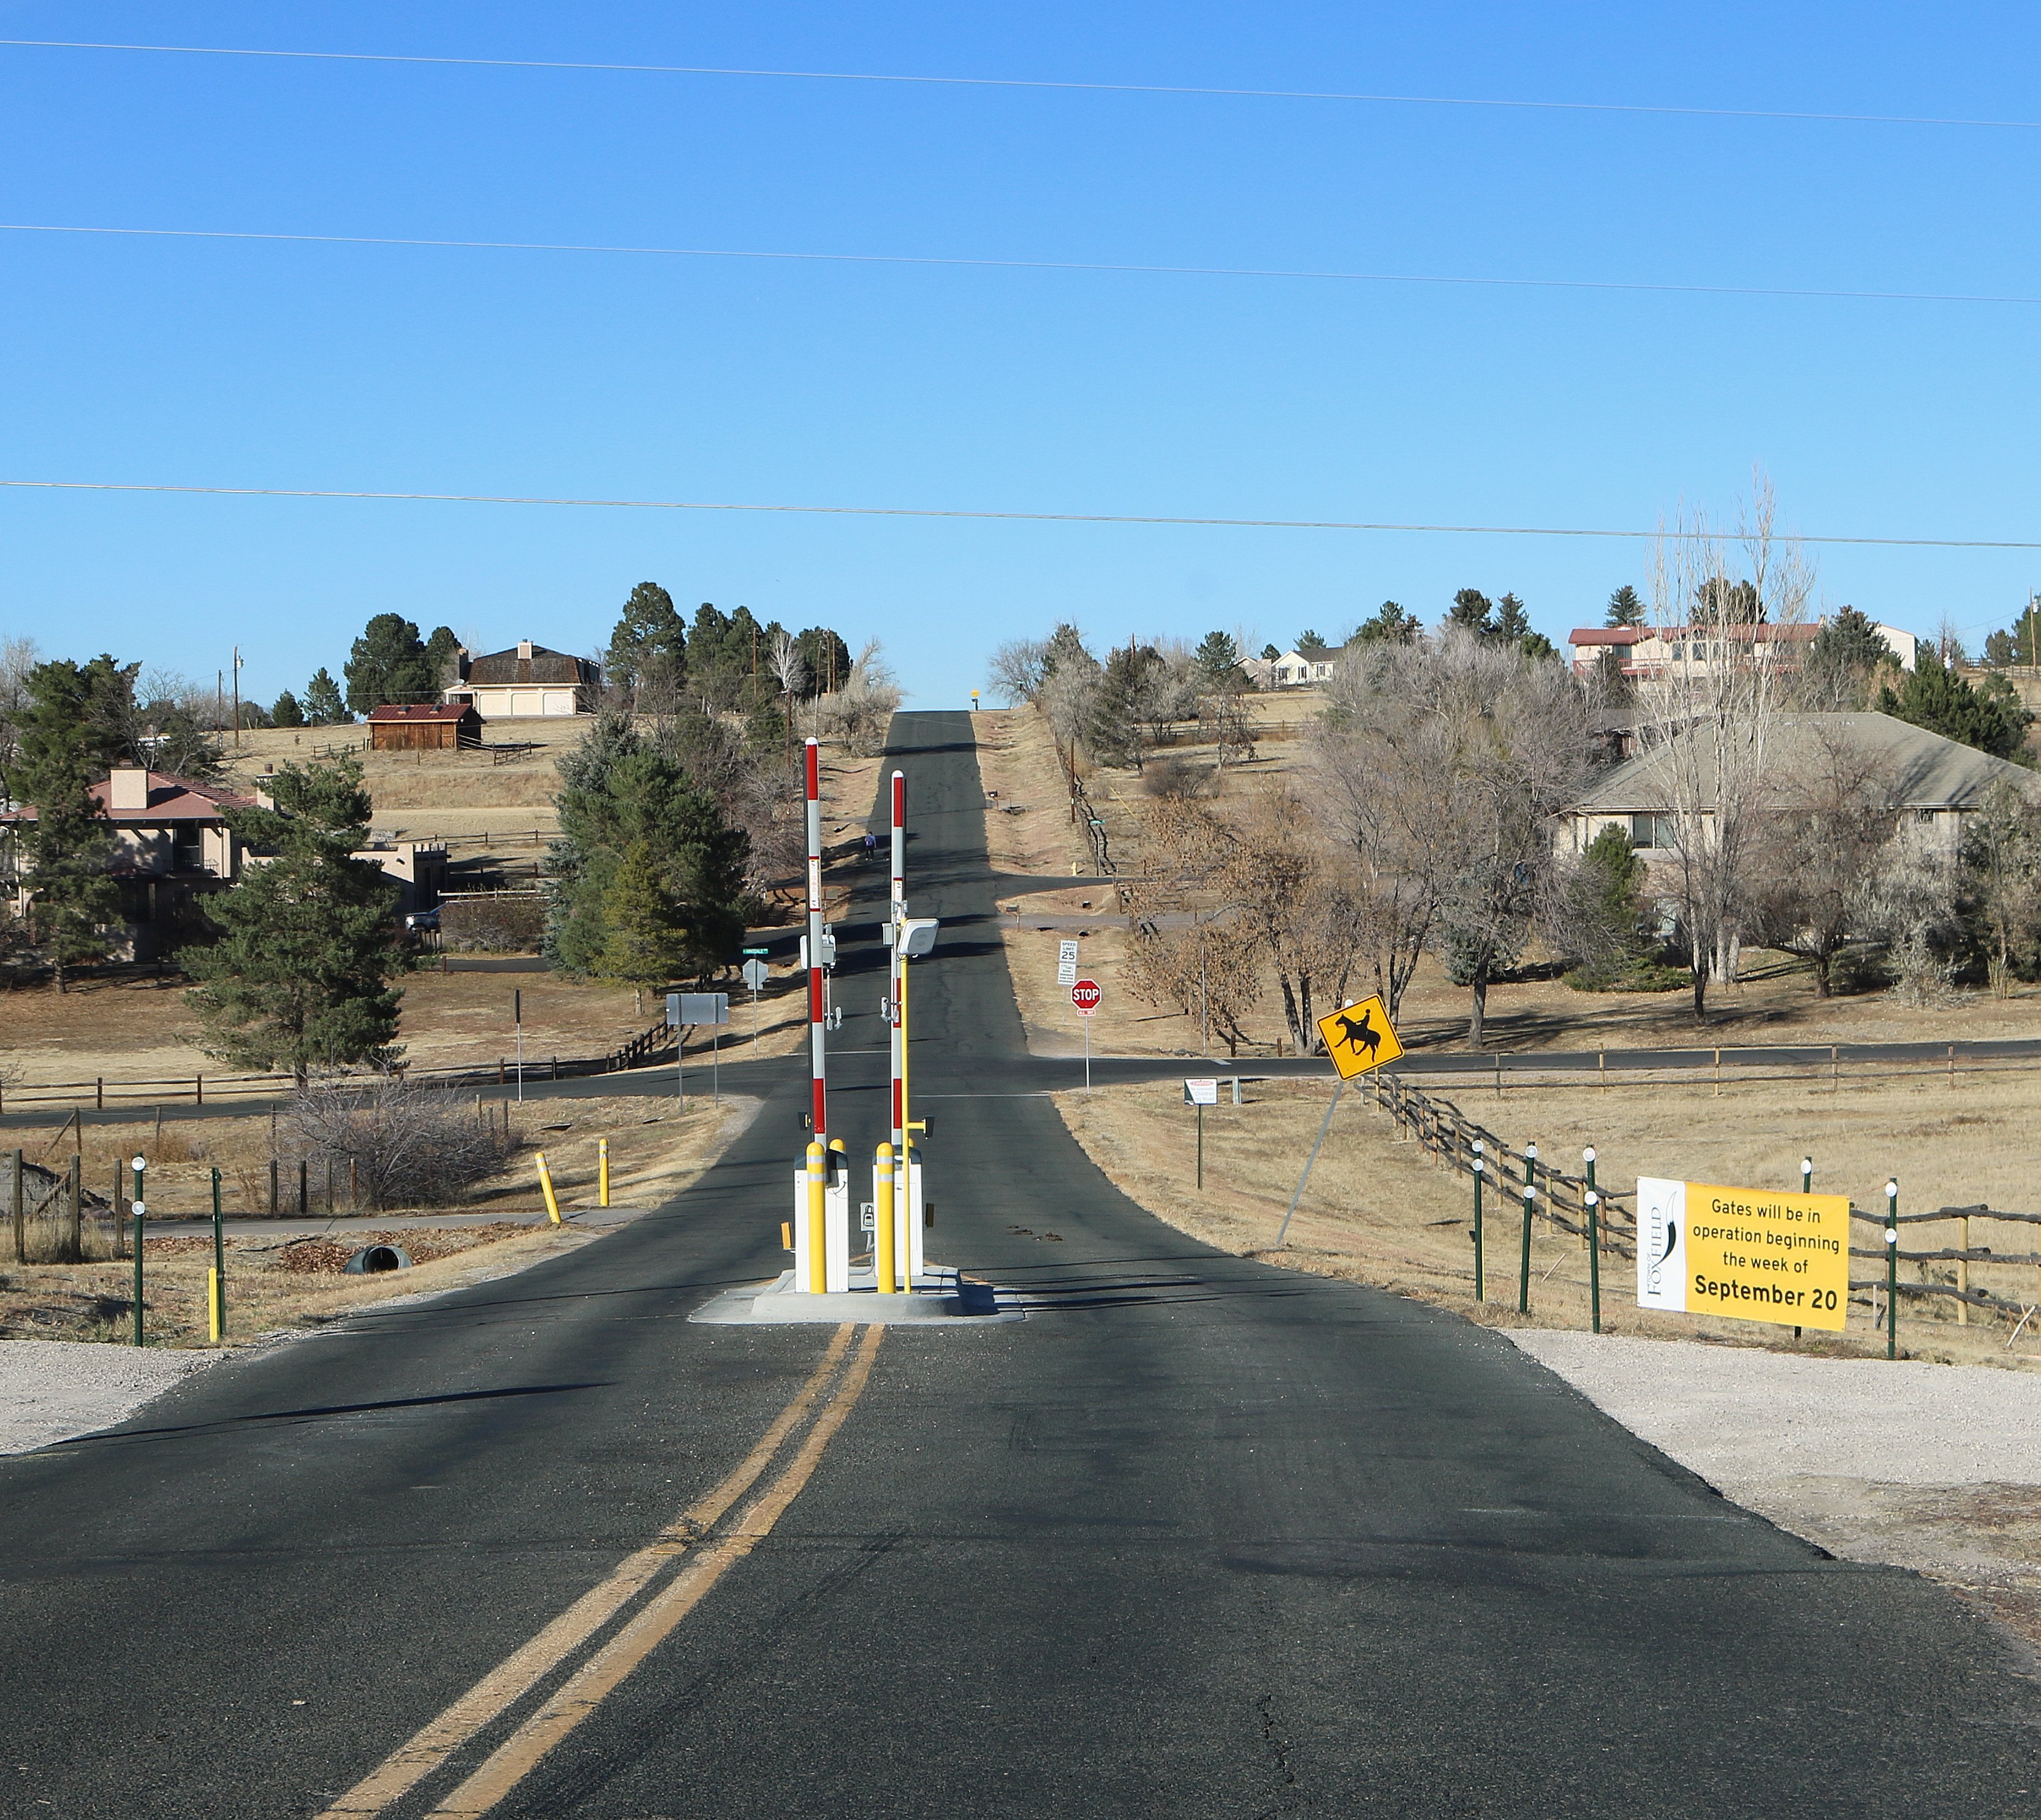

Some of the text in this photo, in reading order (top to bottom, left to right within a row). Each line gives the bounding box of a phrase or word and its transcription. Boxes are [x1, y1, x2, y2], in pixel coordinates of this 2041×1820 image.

[1062, 951, 1075, 960] 25
[1073, 988, 1099, 1001] STOP
[1712, 1199, 1821, 1224] Gates will be in
[1693, 1225, 1839, 1255] operation beginning
[1647, 1253, 1651, 1261] OF
[1648, 1207, 1662, 1298] FOXFIELD
[1723, 1251, 1809, 1274] the week of
[1695, 1274, 1838, 1311] September 20
